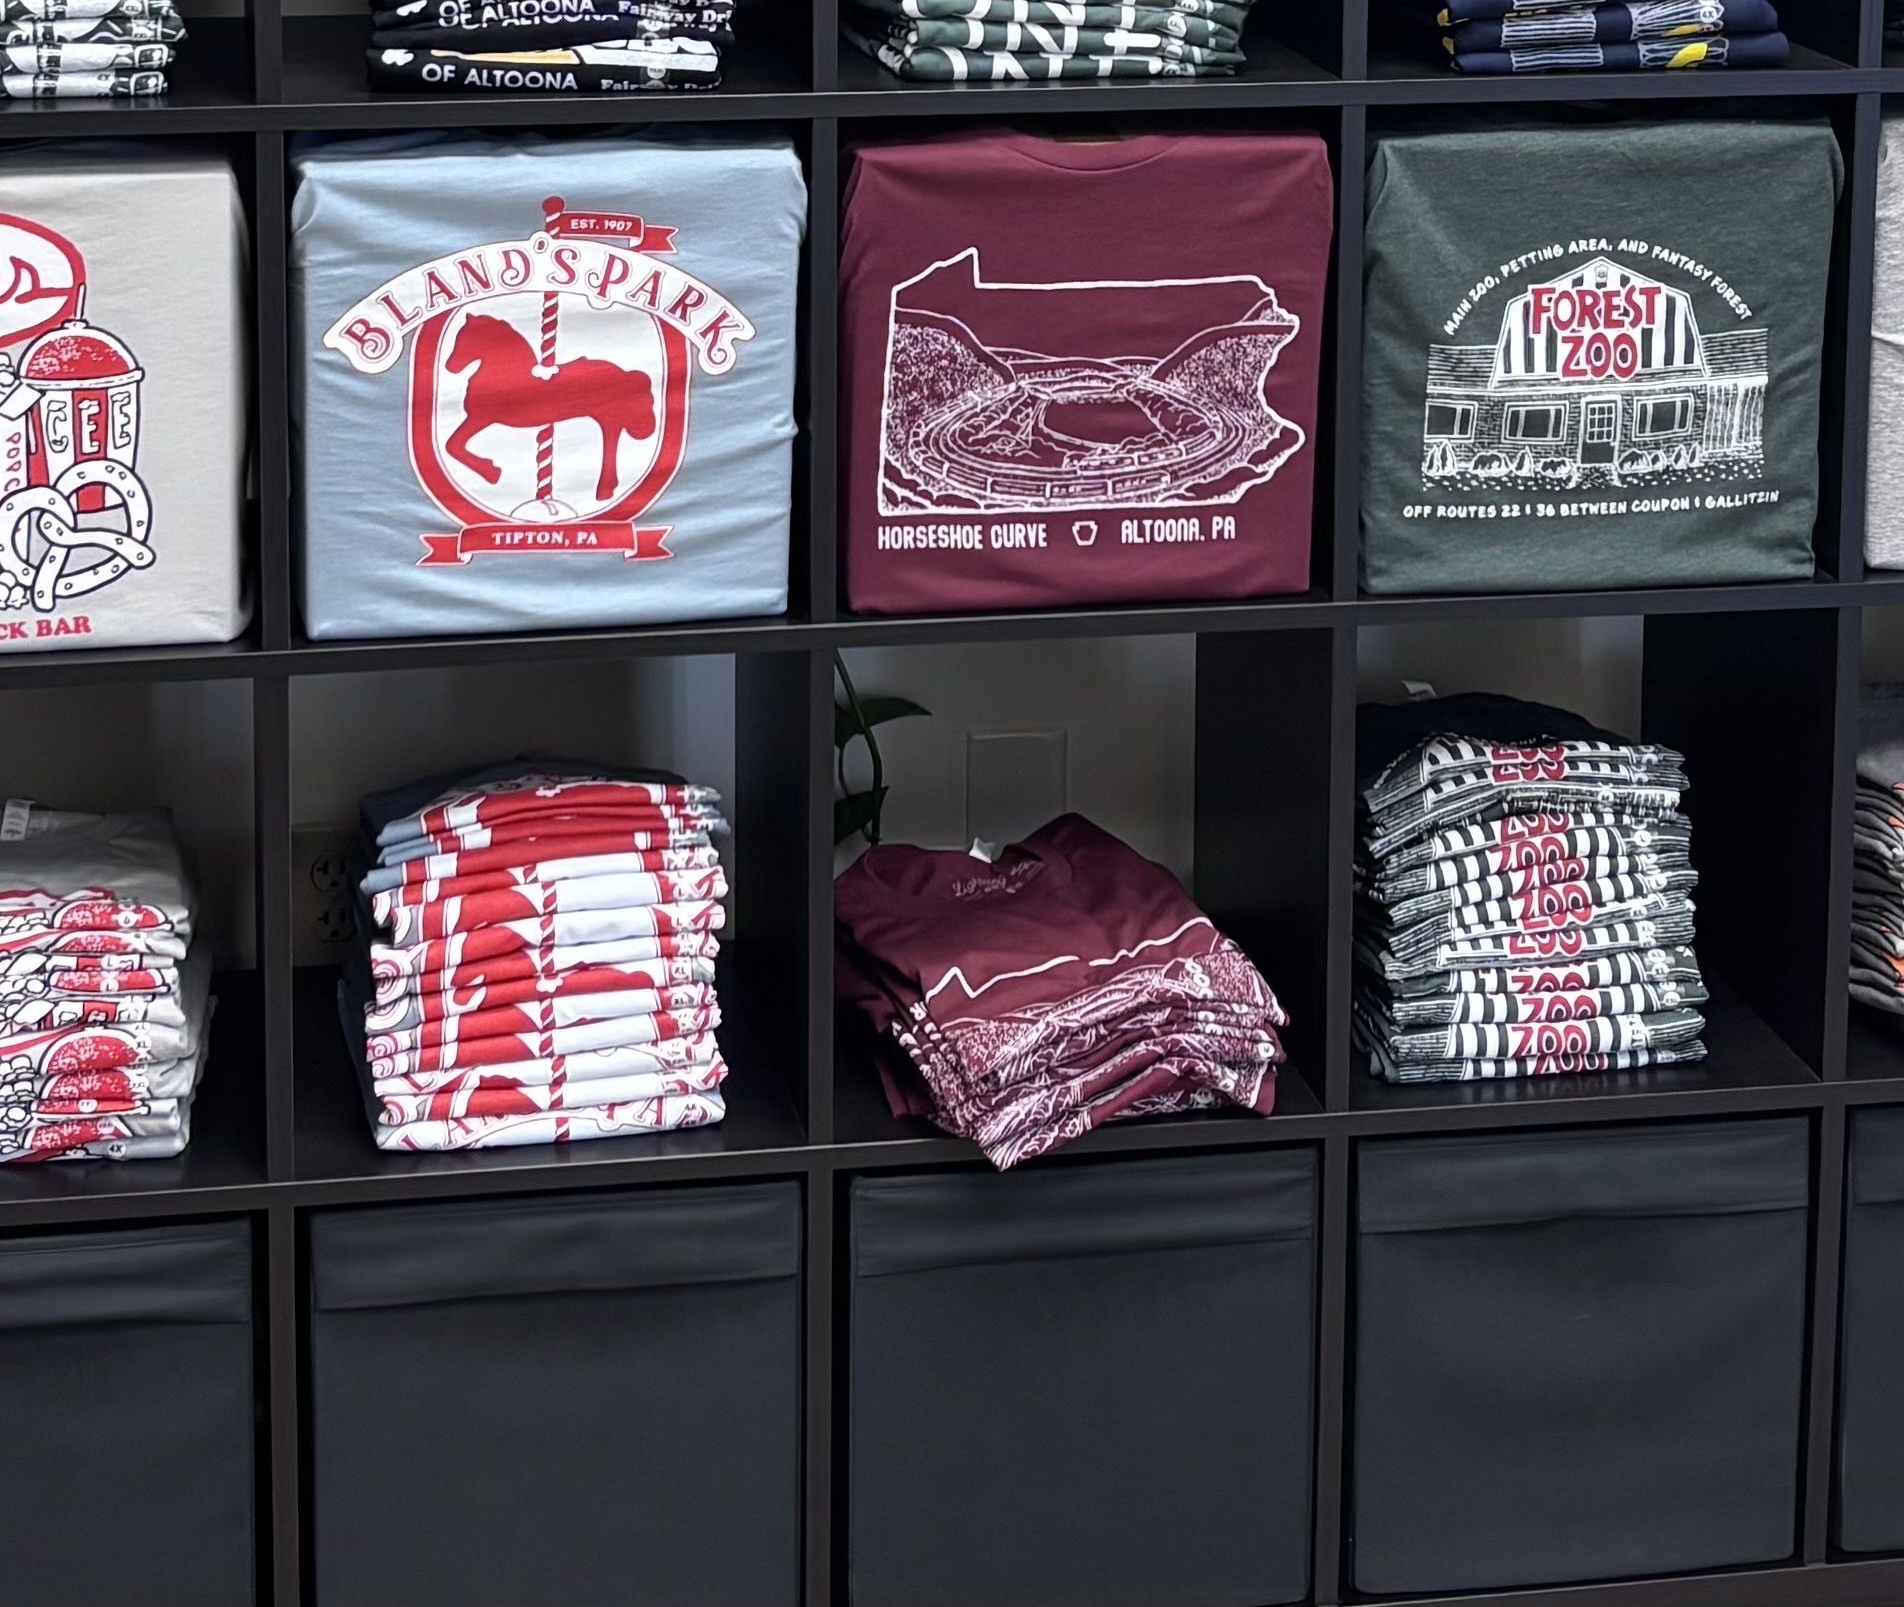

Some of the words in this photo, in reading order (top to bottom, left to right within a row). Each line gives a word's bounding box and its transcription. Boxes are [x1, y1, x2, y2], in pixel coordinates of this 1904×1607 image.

[422, 63, 455, 84] OF
[464, 69, 578, 90] ALTOONA
[570, 217, 600, 231] EST.
[604, 219, 634, 232] 1907
[340, 236, 579, 362] BLAND'S
[587, 253, 746, 367] PARK
[1443, 299, 1473, 336] MAIN
[1500, 244, 1565, 278] PETTING
[1568, 239, 1614, 255] AREA,
[1617, 239, 1649, 255] AND
[1651, 244, 1713, 283] FANTASY
[1710, 276, 1753, 321] FOREST
[1531, 284, 1663, 335] FOREST
[1561, 332, 1639, 379] ZOO
[1403, 505, 1432, 519] OFF
[1437, 504, 1497, 519] ROUTES
[1501, 504, 1521, 517] 22
[1536, 504, 1556, 518] 36
[1560, 501, 1628, 517] BETWEEN
[1631, 497, 1691, 514] COUPON
[1704, 490, 1780, 509] GALLITZIN
[492, 531, 571, 548] TIPTON,
[577, 532, 598, 546] PA
[877, 525, 984, 551] HORSESHOE
[991, 523, 1047, 549] CURVE
[1212, 516, 1236, 541] PA
[36, 615, 93, 637] BAR
[1515, 884, 1592, 921] ZOO
[1512, 1023, 1592, 1059] ZOO
